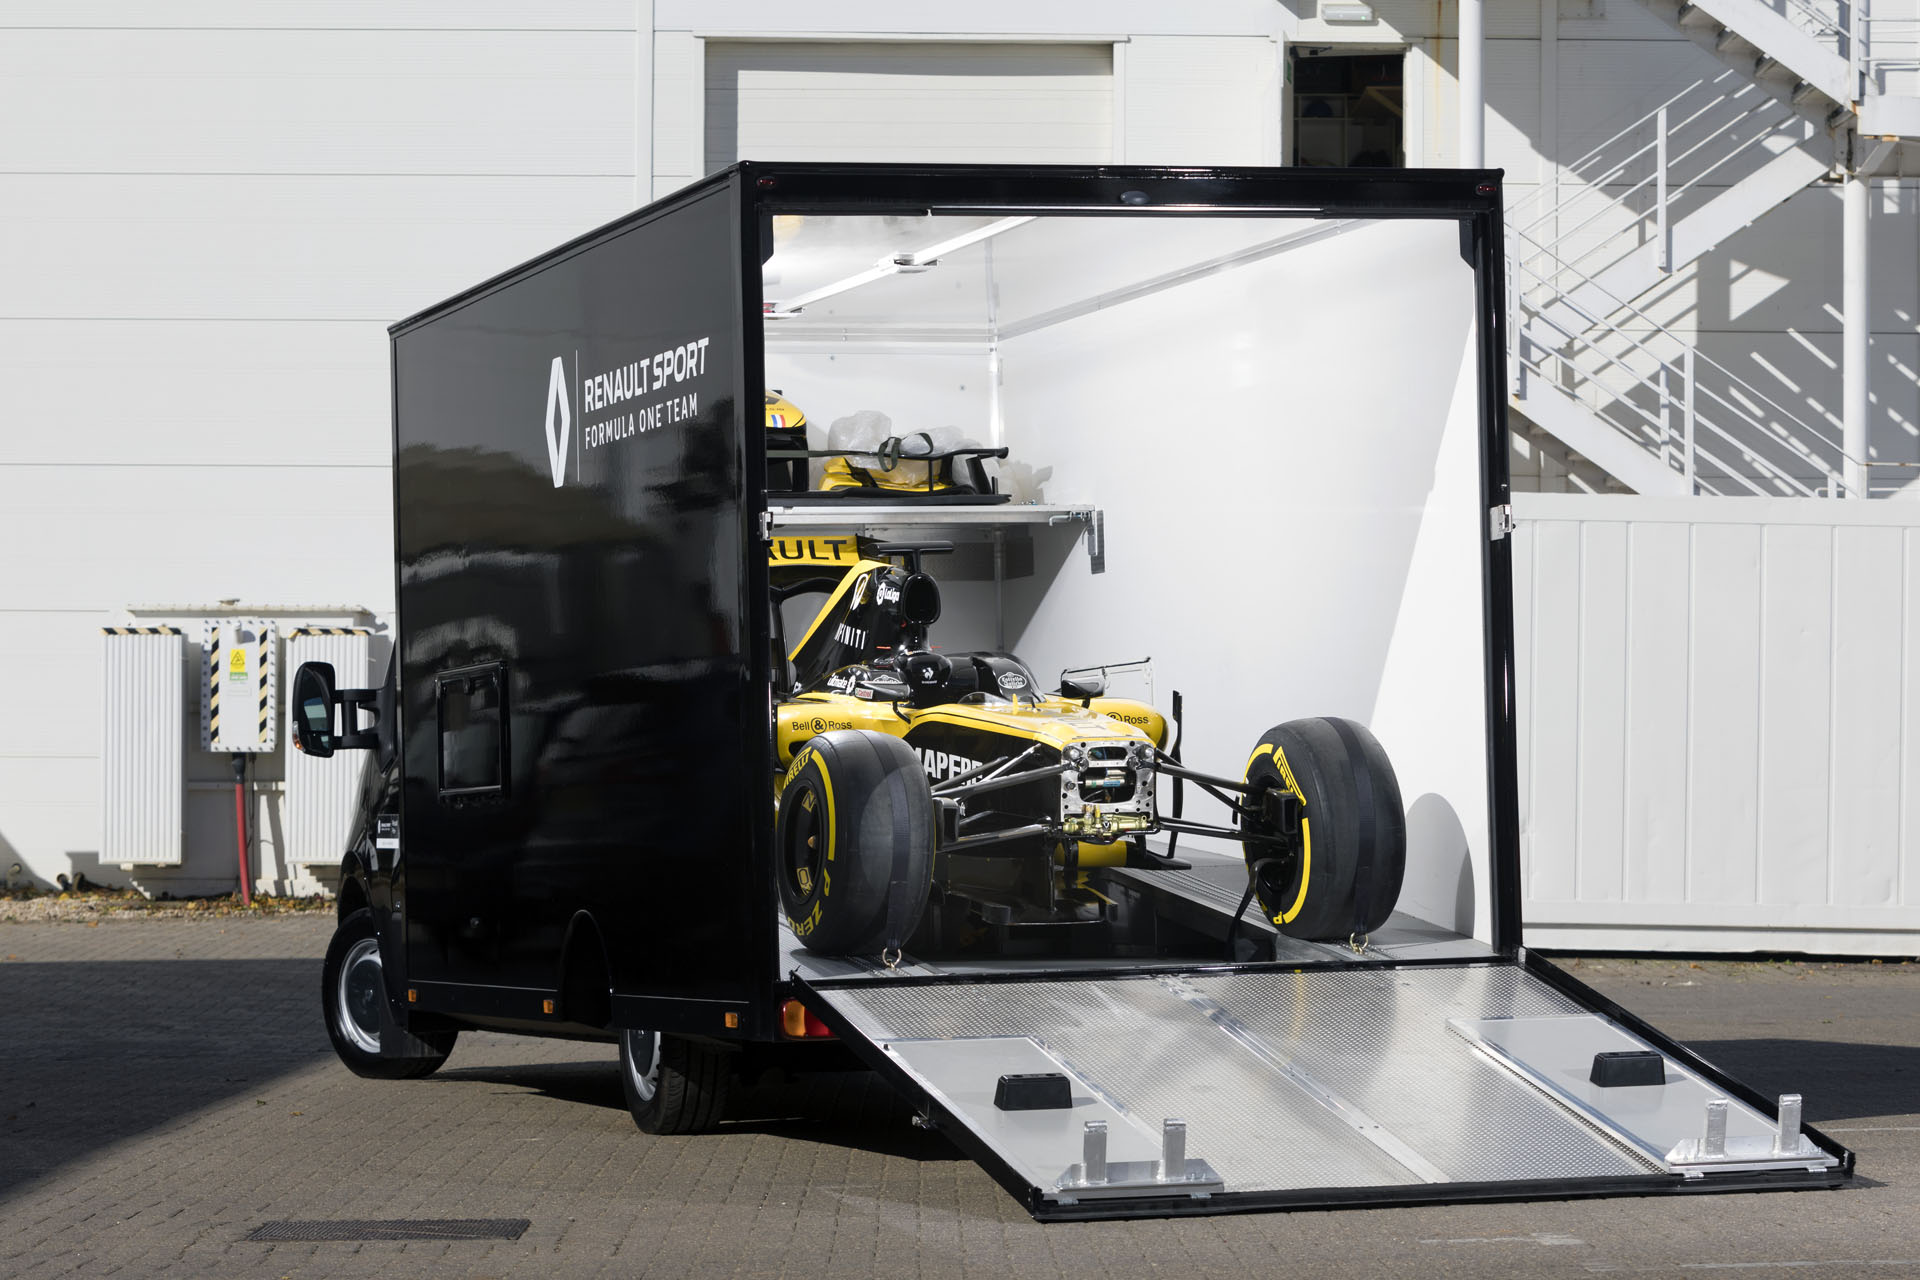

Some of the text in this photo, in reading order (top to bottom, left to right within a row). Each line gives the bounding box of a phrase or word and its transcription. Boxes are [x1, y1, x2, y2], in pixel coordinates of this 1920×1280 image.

[584, 336, 710, 413] RENAULT SPORT
[585, 392, 699, 450] FORMULA ONE TEAM
[792, 721, 810, 731] Bell
[828, 720, 853, 730] Ross
[1123, 715, 1150, 725] Ross
